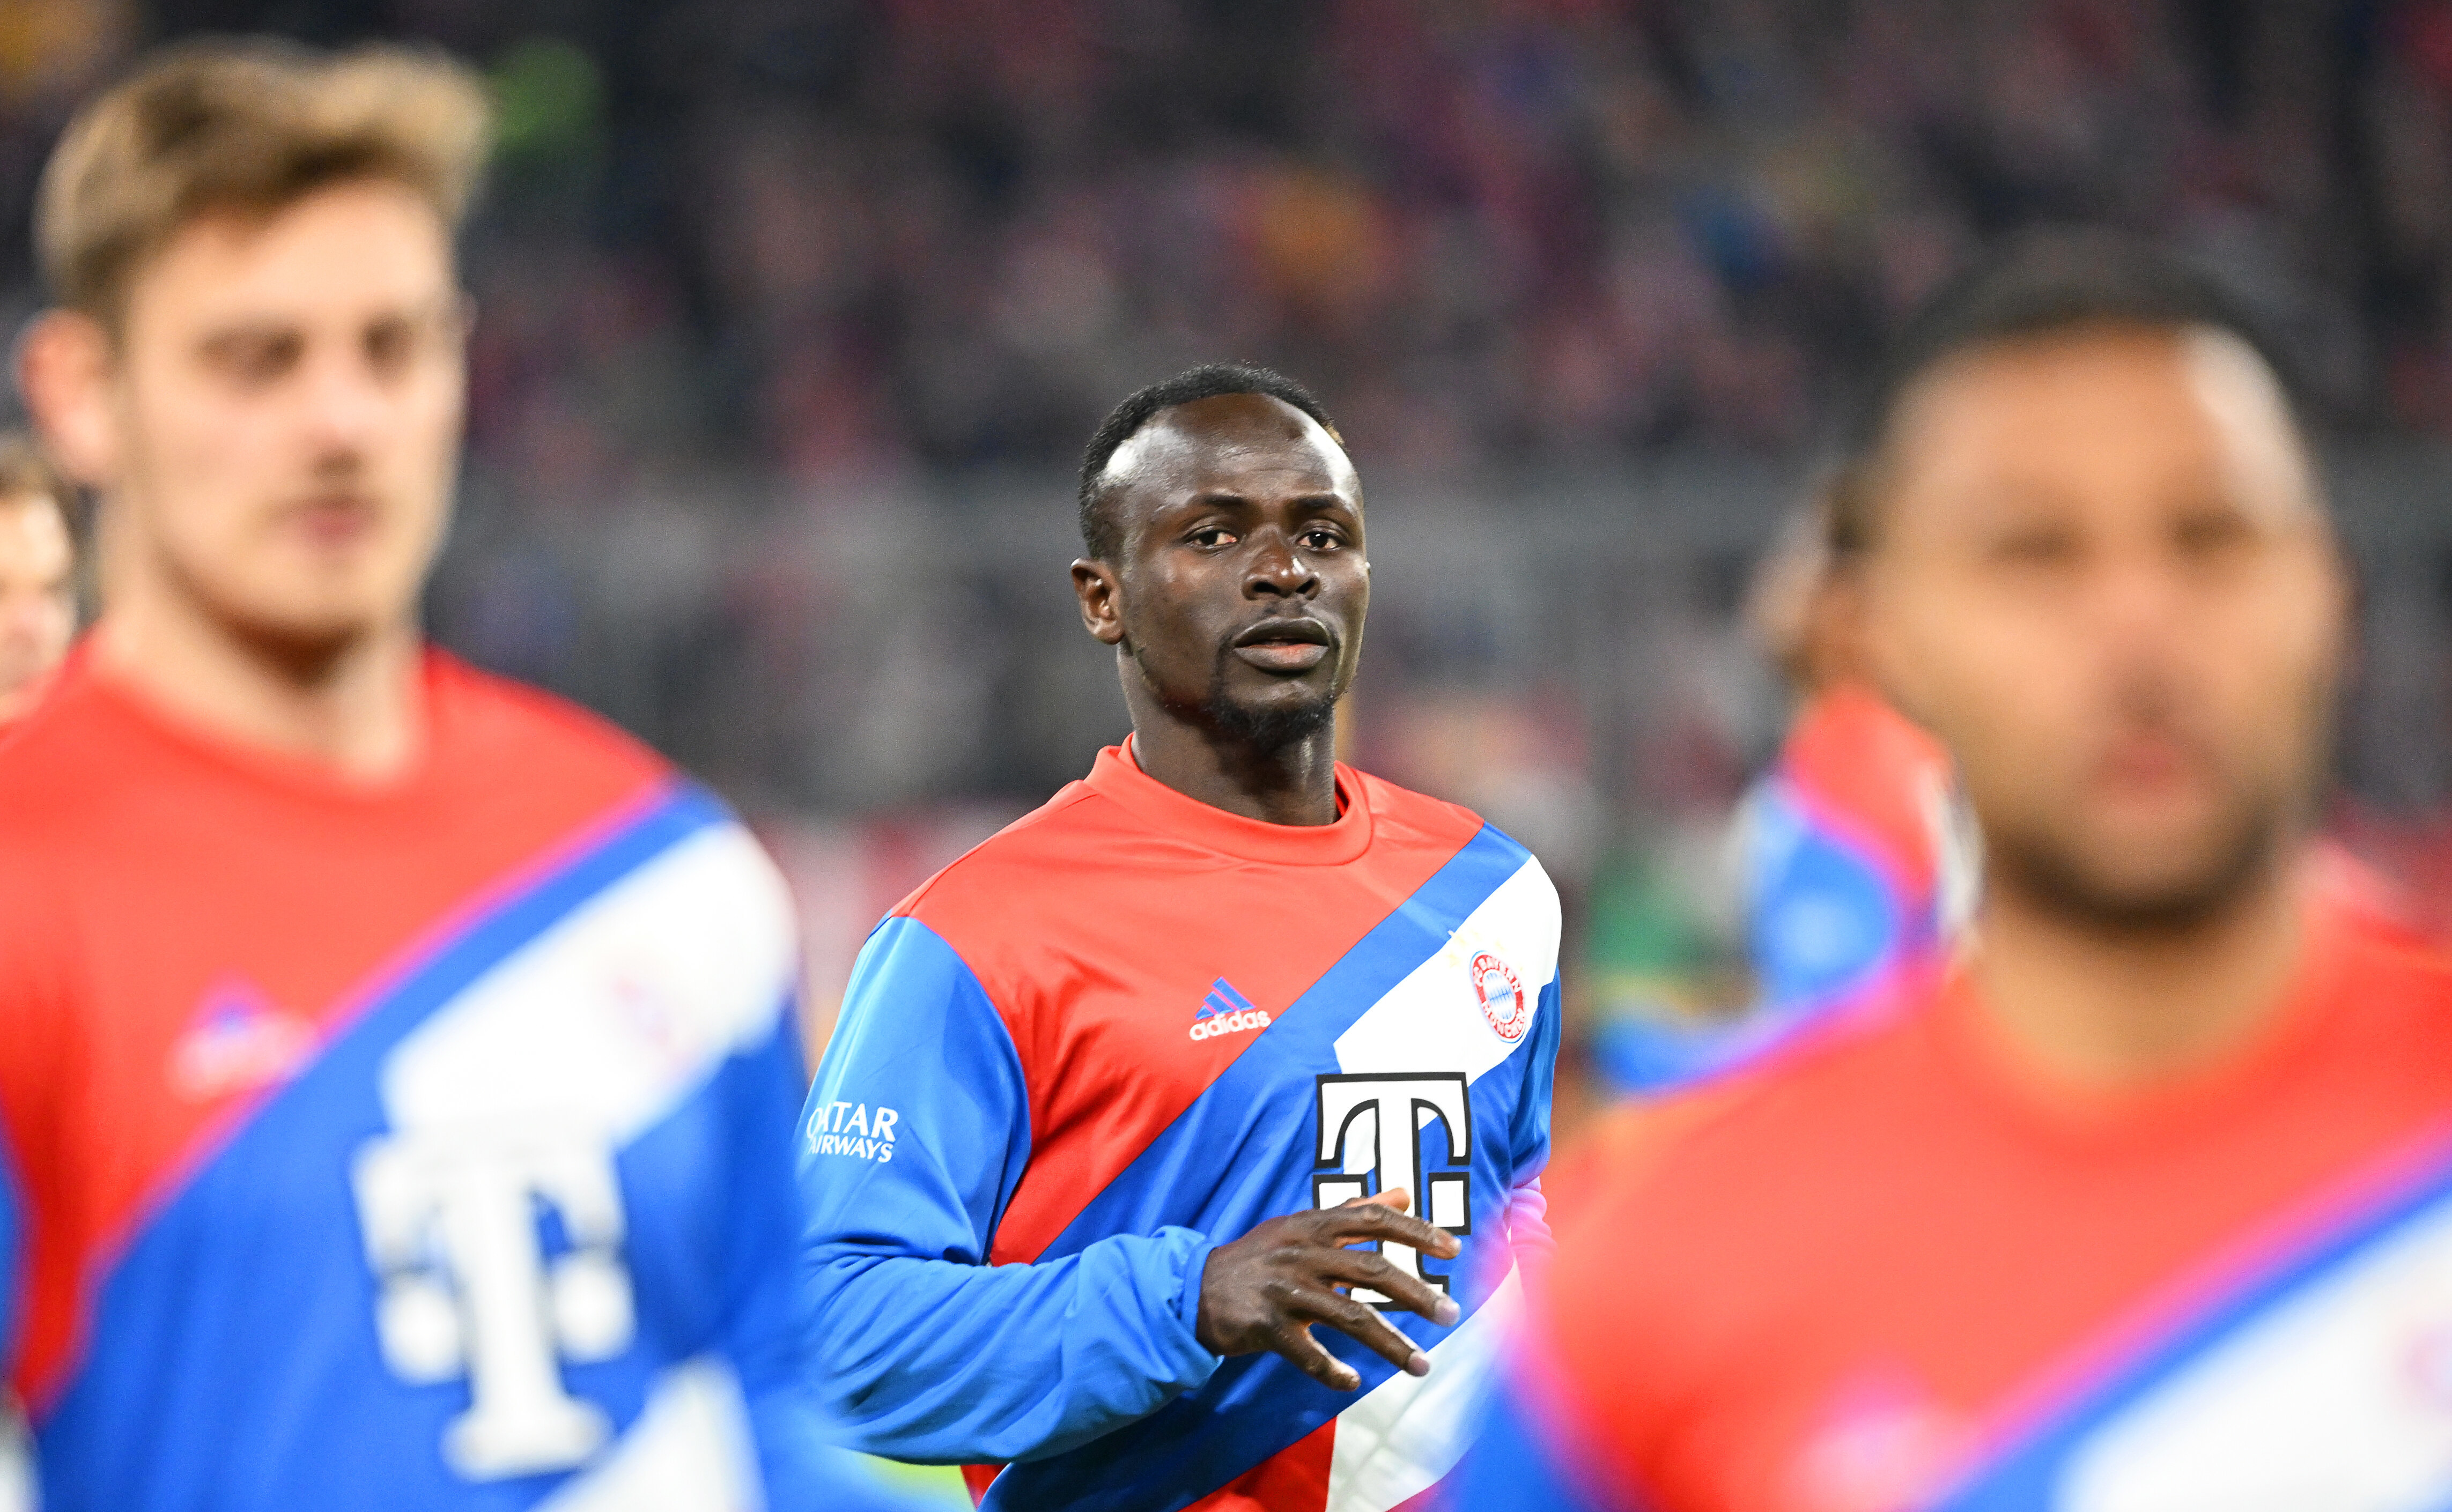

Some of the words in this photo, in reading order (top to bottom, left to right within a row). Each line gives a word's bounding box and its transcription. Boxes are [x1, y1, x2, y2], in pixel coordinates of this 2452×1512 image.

[1189, 1010, 1272, 1041] adidas
[806, 1101, 898, 1143] QATAR
[806, 1135, 894, 1163] AIRWAYS
[1312, 1072, 1472, 1312] T
